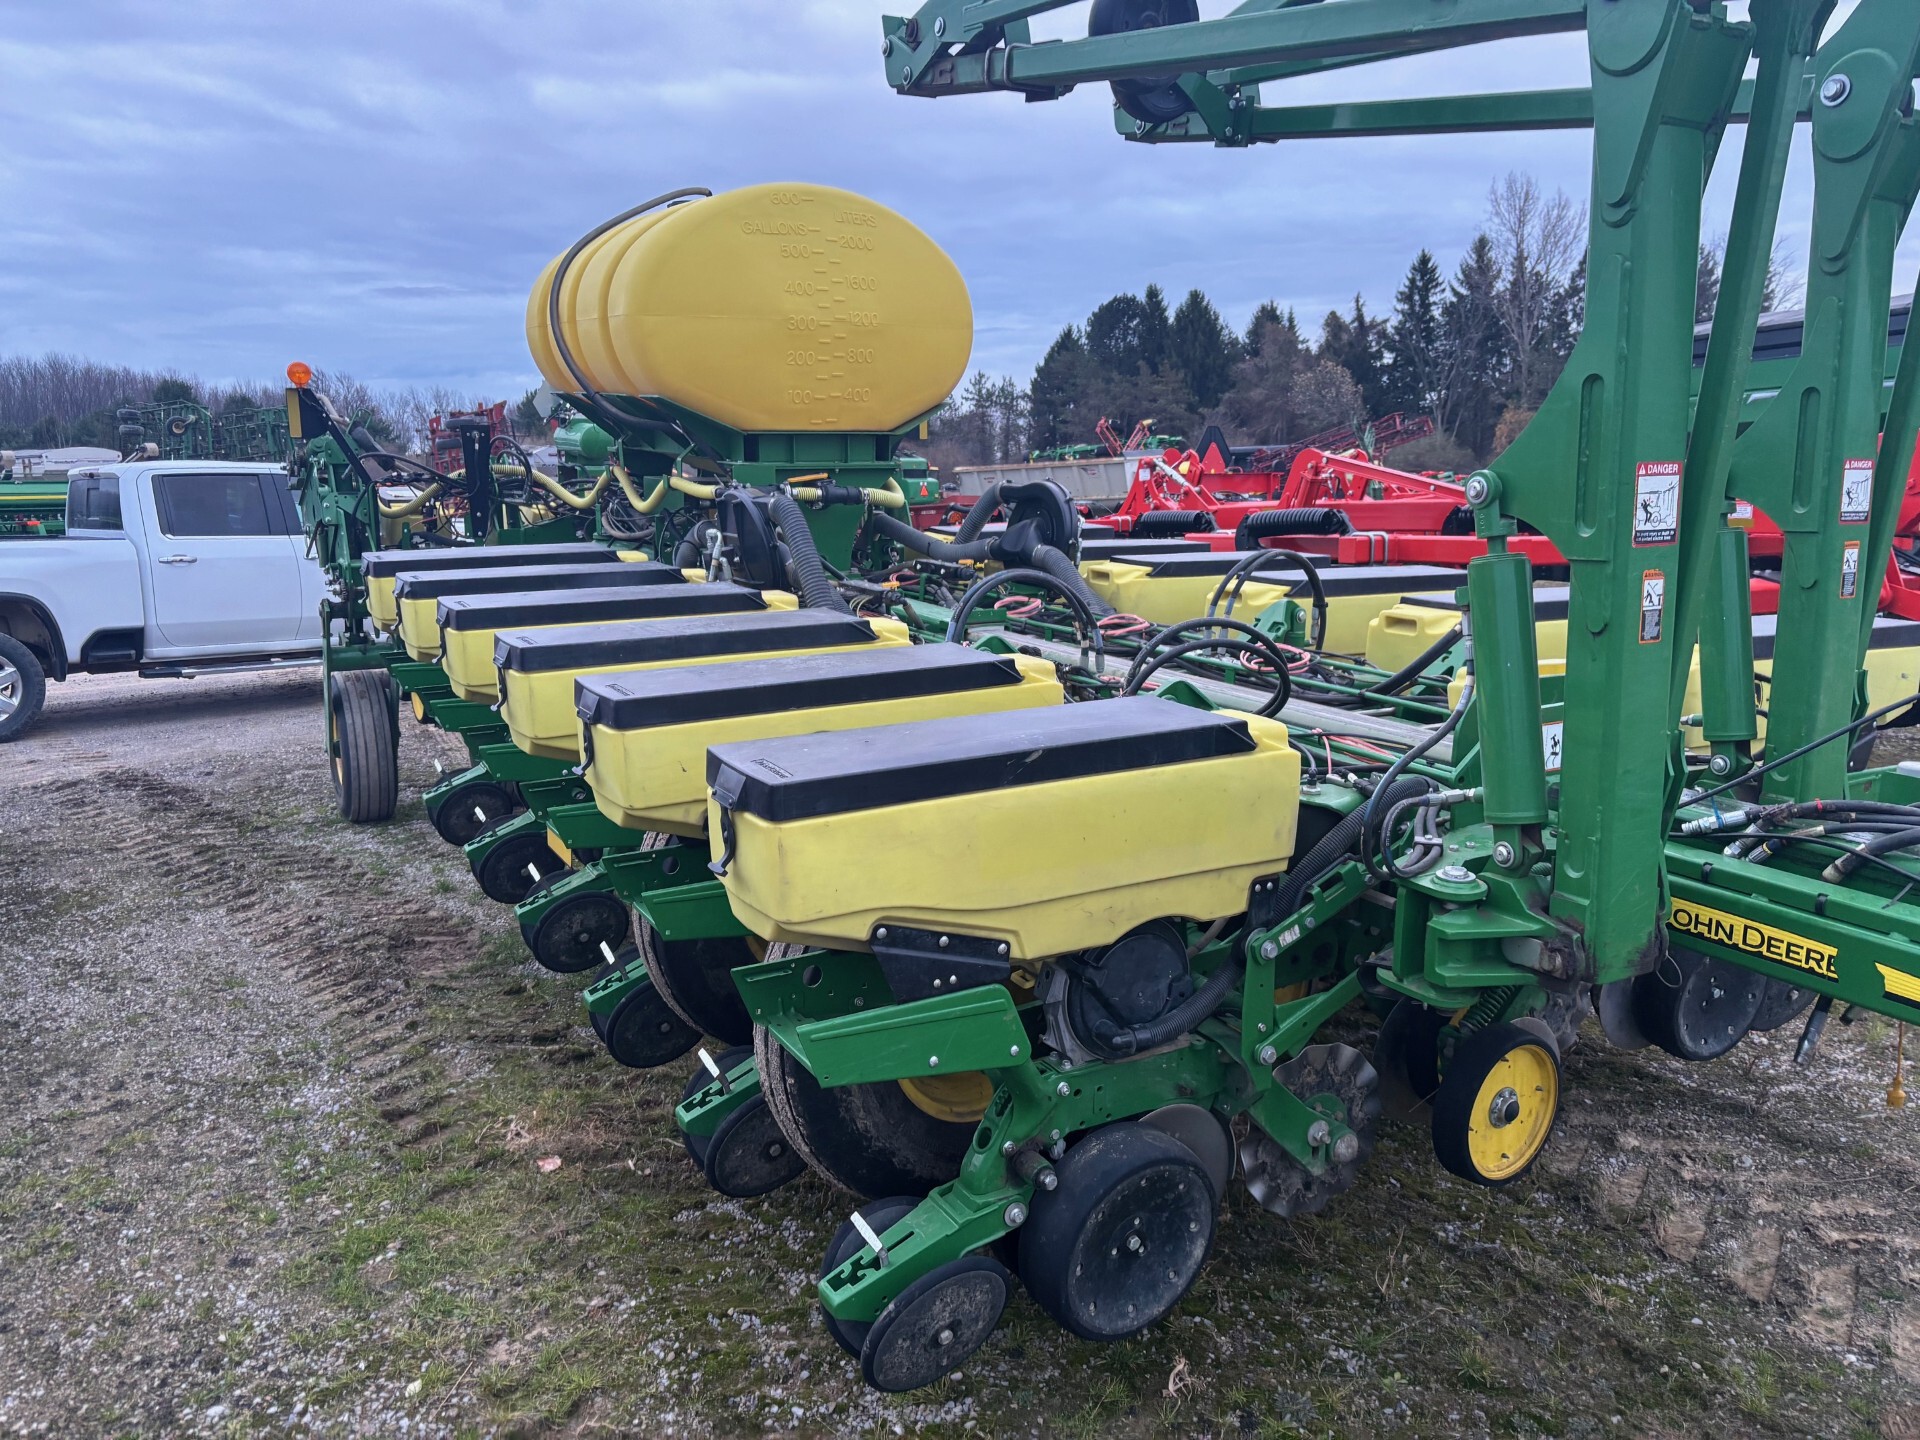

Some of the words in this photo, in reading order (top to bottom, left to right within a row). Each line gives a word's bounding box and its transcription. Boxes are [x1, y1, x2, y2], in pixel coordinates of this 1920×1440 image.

[771, 191, 801, 205] 600
[834, 210, 877, 228] LITERS
[741, 221, 808, 236] GALLONS
[781, 243, 810, 258] 500
[840, 235, 873, 251] 2000
[784, 281, 815, 296] 400
[845, 275, 877, 291] 1600
[787, 315, 817, 330] 300
[848, 311, 879, 327] 1200
[786, 351, 816, 365] 200
[847, 348, 874, 363] 800
[788, 390, 813, 404] 100
[843, 388, 871, 404] 400
[1647, 463, 1679, 474] DANGER
[1850, 460, 1873, 469] DANGER
[1672, 908, 1734, 942] OHN
